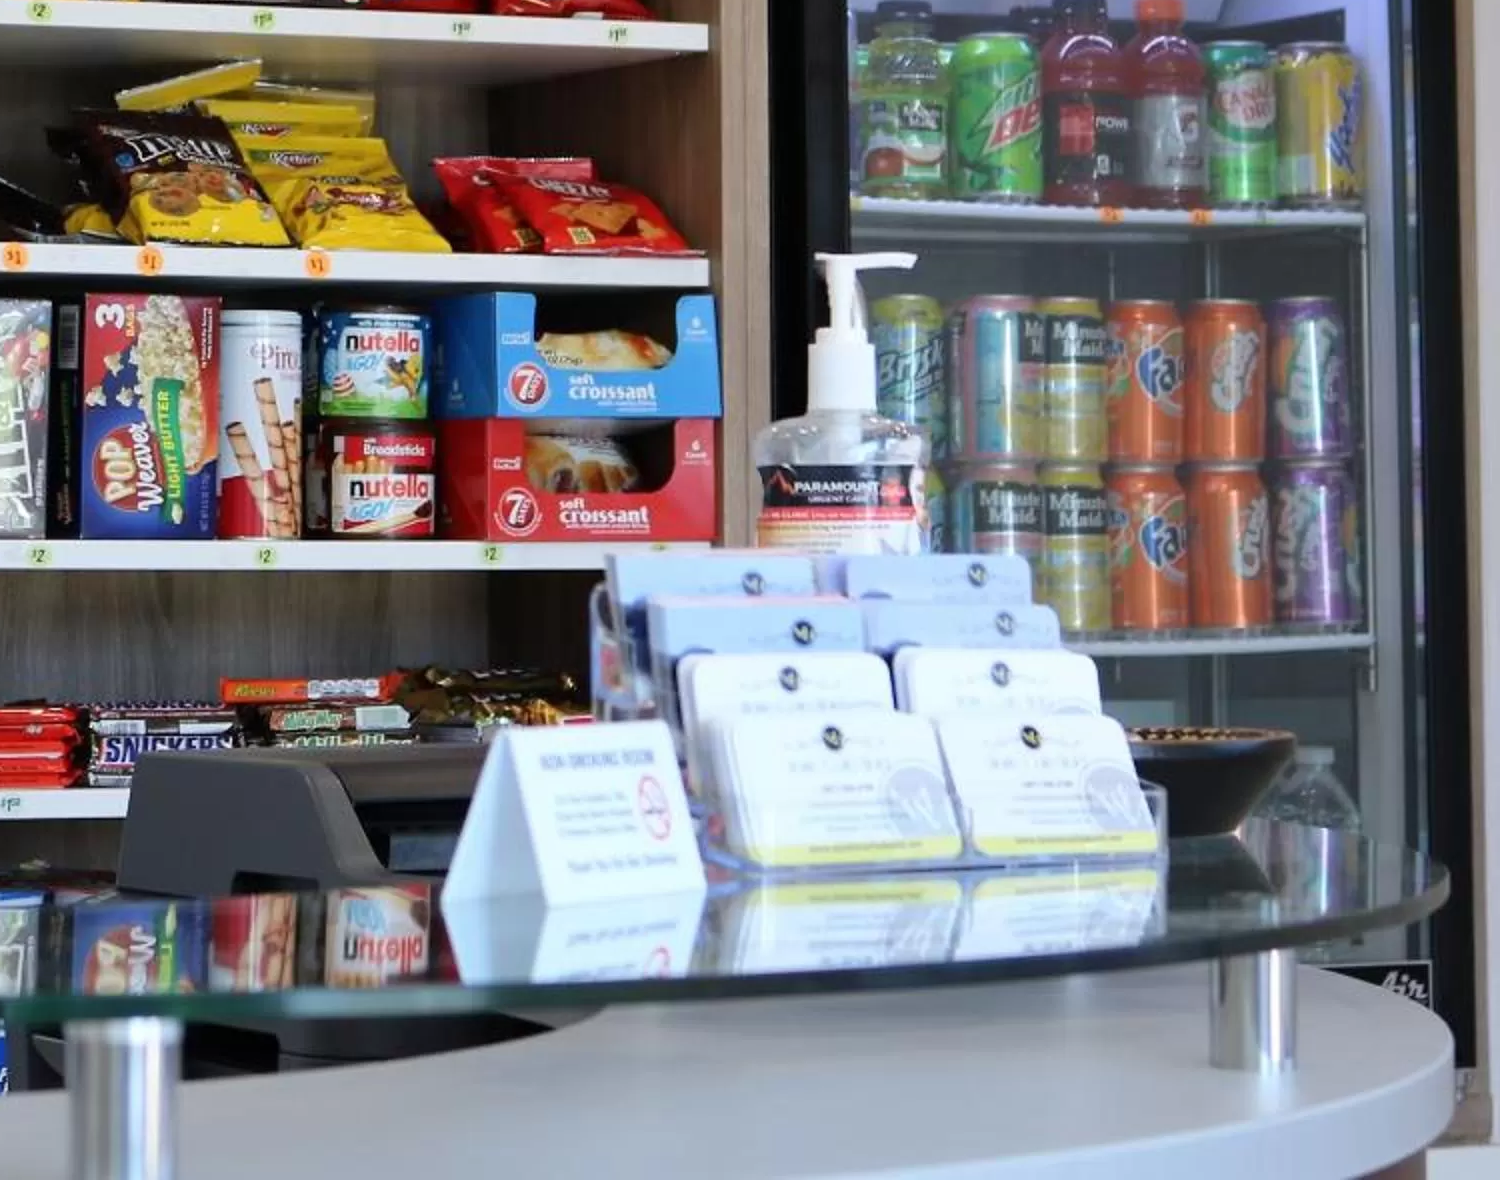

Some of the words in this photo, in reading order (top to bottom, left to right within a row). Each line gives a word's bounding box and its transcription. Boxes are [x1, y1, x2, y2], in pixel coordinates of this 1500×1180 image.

[95, 303, 125, 330] 3
[125, 304, 136, 338] BAGS
[345, 331, 421, 354] nutella
[877, 338, 944, 386] Brisk
[514, 369, 532, 400] 7
[568, 373, 595, 385] soft
[568, 381, 657, 400] croissant
[157, 390, 174, 451] BUTTER
[104, 438, 129, 503] POP
[130, 421, 156, 512] Weaver
[167, 454, 181, 499] LIGHT
[350, 475, 429, 499] nutella
[794, 480, 879, 494] PARAMOUNT
[504, 493, 526, 526] 7
[559, 497, 585, 510] soft
[559, 506, 649, 523] croissant
[988, 506, 1037, 526] Maid
[1059, 510, 1103, 529] Maid
